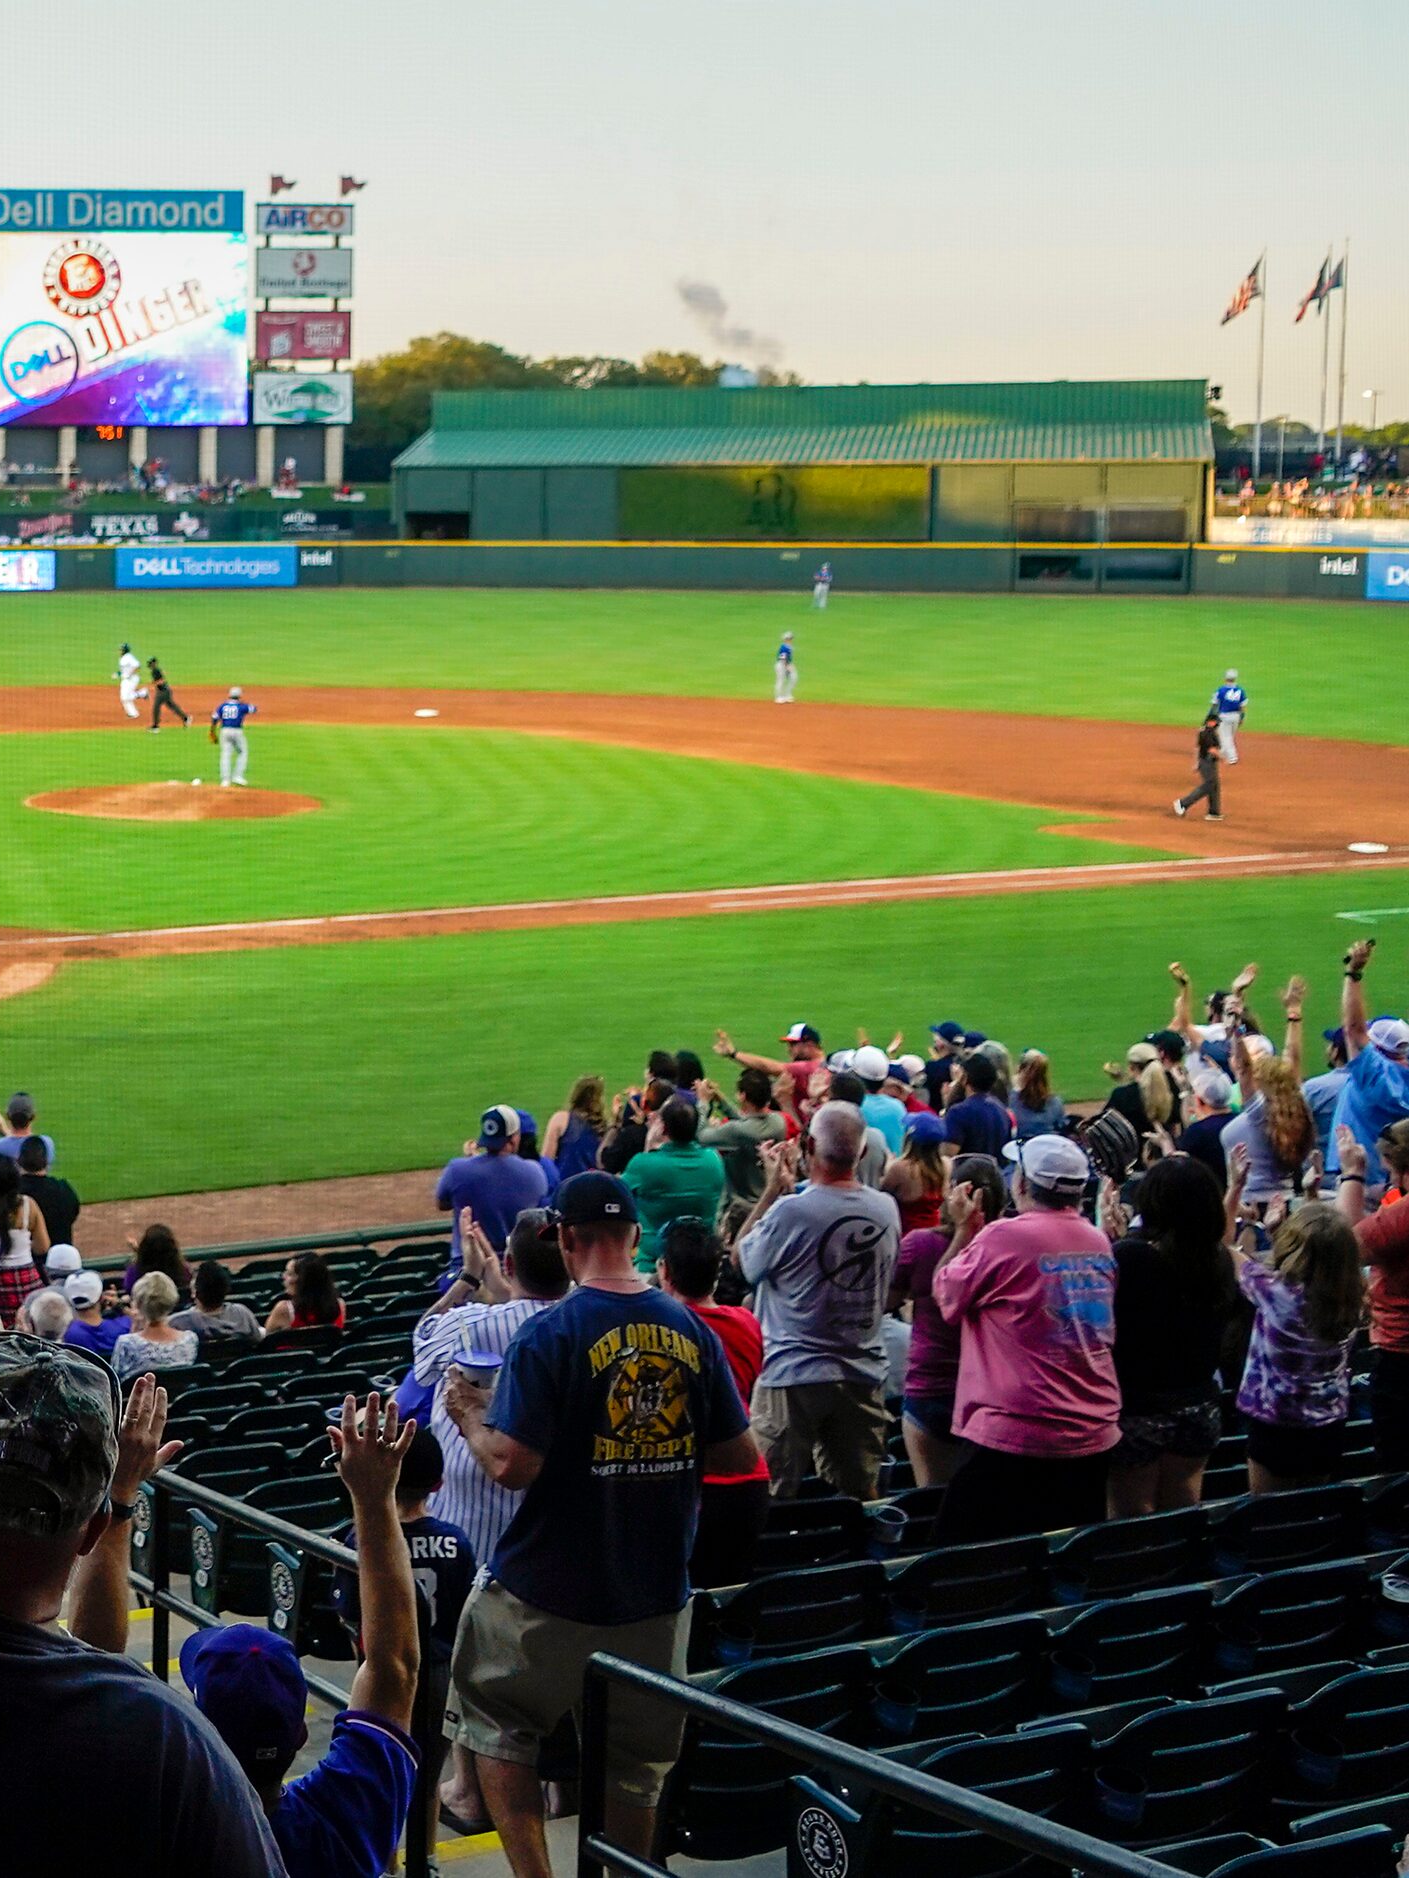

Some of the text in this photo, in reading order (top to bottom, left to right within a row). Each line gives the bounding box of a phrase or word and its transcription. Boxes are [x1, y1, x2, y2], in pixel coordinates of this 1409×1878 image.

[68, 193, 225, 227] Diamond
[10, 345, 71, 381] DELL
[133, 558, 280, 578] DELL Technologies
[588, 1323, 702, 1379] NEW ORLEANS
[593, 1434, 635, 1461] FIRE
[640, 1461, 685, 1474] LADDER
[411, 1535, 458, 1559] RKS
